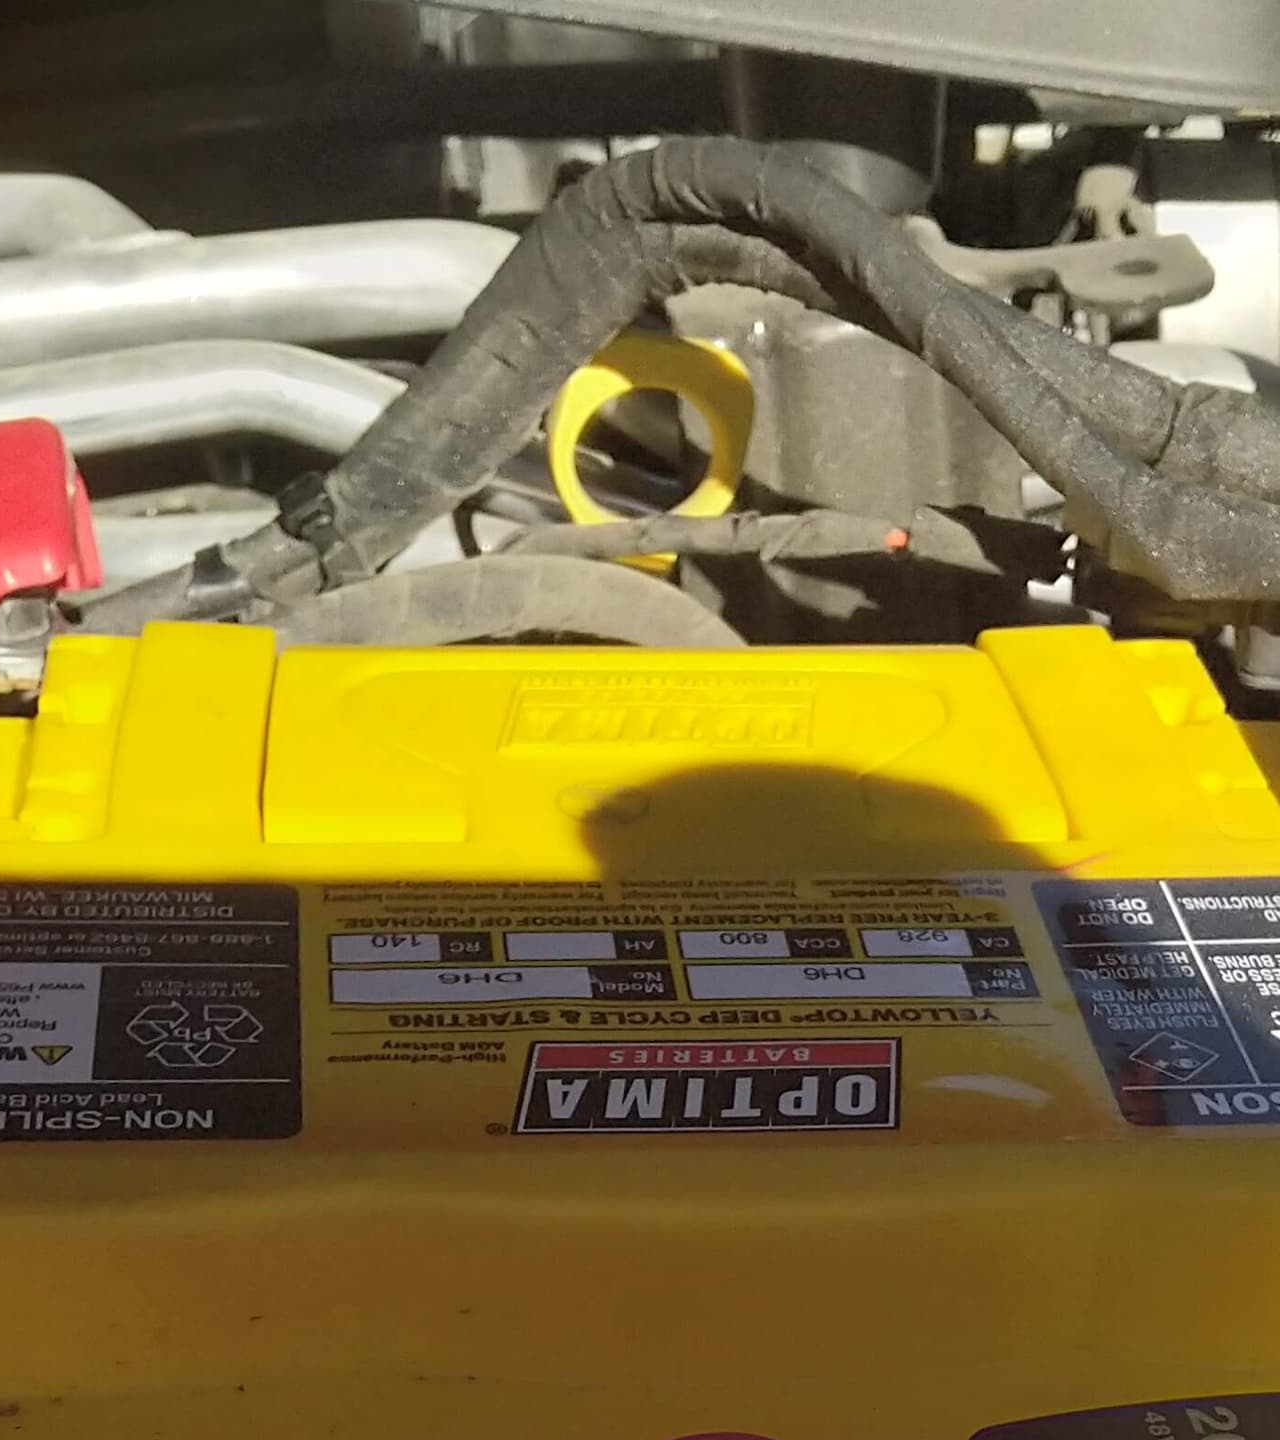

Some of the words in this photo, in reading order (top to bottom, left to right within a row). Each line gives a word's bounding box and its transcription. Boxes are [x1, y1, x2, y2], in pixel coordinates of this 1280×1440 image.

[15, 890, 46, 903] WI
[64, 905, 234, 918] DISTRIBUTED
[851, 912, 909, 924] FREE
[912, 911, 1001, 923] 3-YEAR
[1122, 911, 1154, 926] DO
[479, 915, 512, 927] OF
[516, 915, 598, 927] PROOF
[601, 914, 662, 926] WITH
[670, 912, 845, 926] REPLACEMENT
[1077, 912, 1120, 926] NOT
[371, 933, 420, 949] 140
[624, 939, 656, 952] AH
[718, 932, 769, 946] 800
[793, 937, 842, 950] CCA
[978, 936, 1010, 949] CA
[55, 945, 152, 956] Customer
[448, 940, 481, 954] RC
[1141, 951, 1187, 965] HELP
[1208, 953, 1271, 969] BURNS.
[436, 972, 523, 984] DH6
[802, 966, 866, 981] DH6
[1074, 966, 1156, 981] MEDICAL
[1158, 964, 1196, 978] GET
[1219, 968, 1248, 983] OR
[599, 980, 664, 994] Model
[980, 977, 1026, 992] Part
[1158, 986, 1203, 1001] WITH
[1091, 1000, 1210, 1016] IMMEDIATELY
[387, 1009, 551, 1029] STARTING
[558, 1009, 583, 1027] &
[589, 1009, 691, 1026] CYCLE
[698, 1008, 782, 1026] DEEP
[1159, 1014, 1218, 1029] FLUSH
[173, 1027, 211, 1041] Pb
[381, 1039, 455, 1052] Battery
[459, 1040, 505, 1051] AGM
[606, 1047, 811, 1064] BATTERIES
[35, 1092, 94, 1108] Acid
[99, 1092, 163, 1107] Lead
[544, 1073, 877, 1119] OPTIMA
